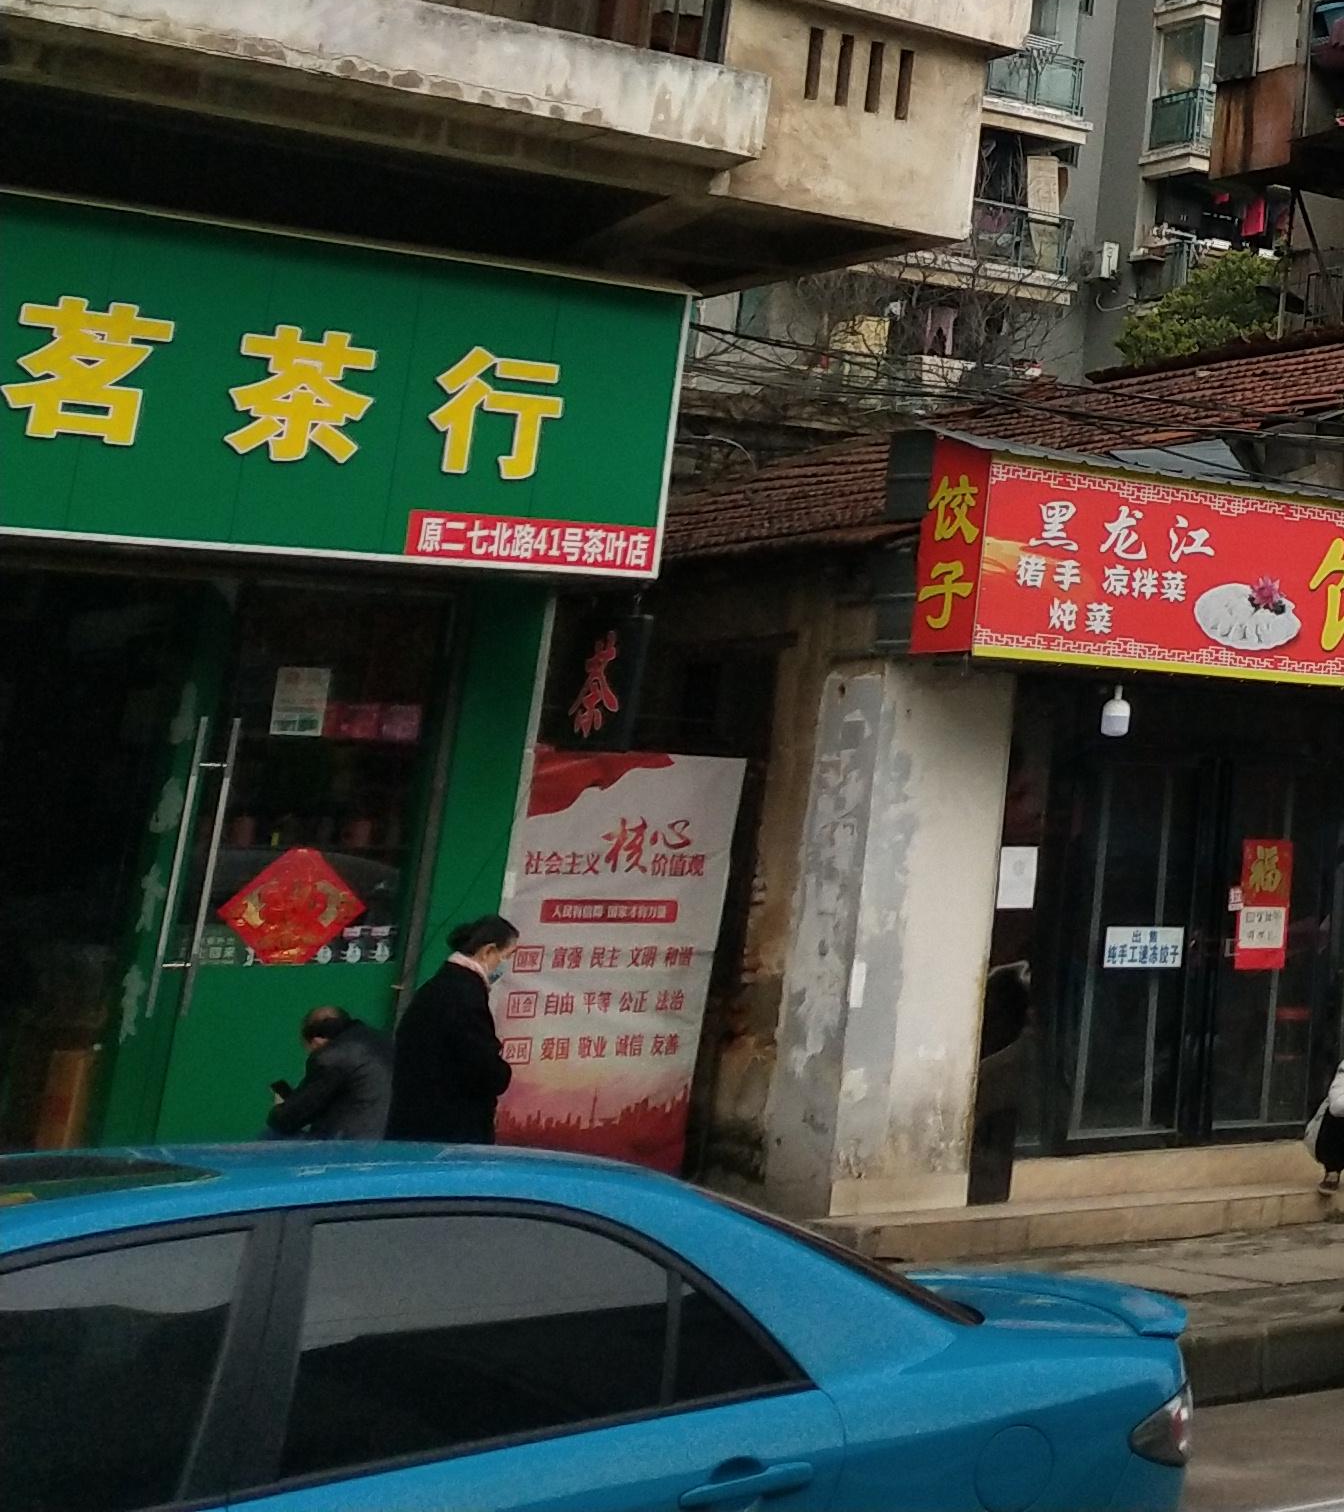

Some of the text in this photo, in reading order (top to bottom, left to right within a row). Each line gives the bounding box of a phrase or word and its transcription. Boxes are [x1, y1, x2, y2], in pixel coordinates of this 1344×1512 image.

[2, 295, 565, 481] 茗茶行
[416, 517, 650, 569] 原二七北路41号茶叶店
[917, 475, 980, 631] 饺子
[1028, 500, 1217, 562] 黑龙江
[1016, 554, 1188, 605] 猪手 凉拌菜
[1049, 598, 1114, 636] 炖菜
[567, 629, 621, 739] 茶
[1249, 845, 1283, 893] 福
[515, 946, 694, 970] 国家 富强 民主 文明 和谐
[1107, 944, 1180, 965] 纯手工速冻饺子
[1132, 930, 1159, 944] 出售
[510, 991, 685, 1017] 社会 自由 平等 公正 法治
[505, 1034, 680, 1062] 公民 爱国 敬业 诚信 友善
